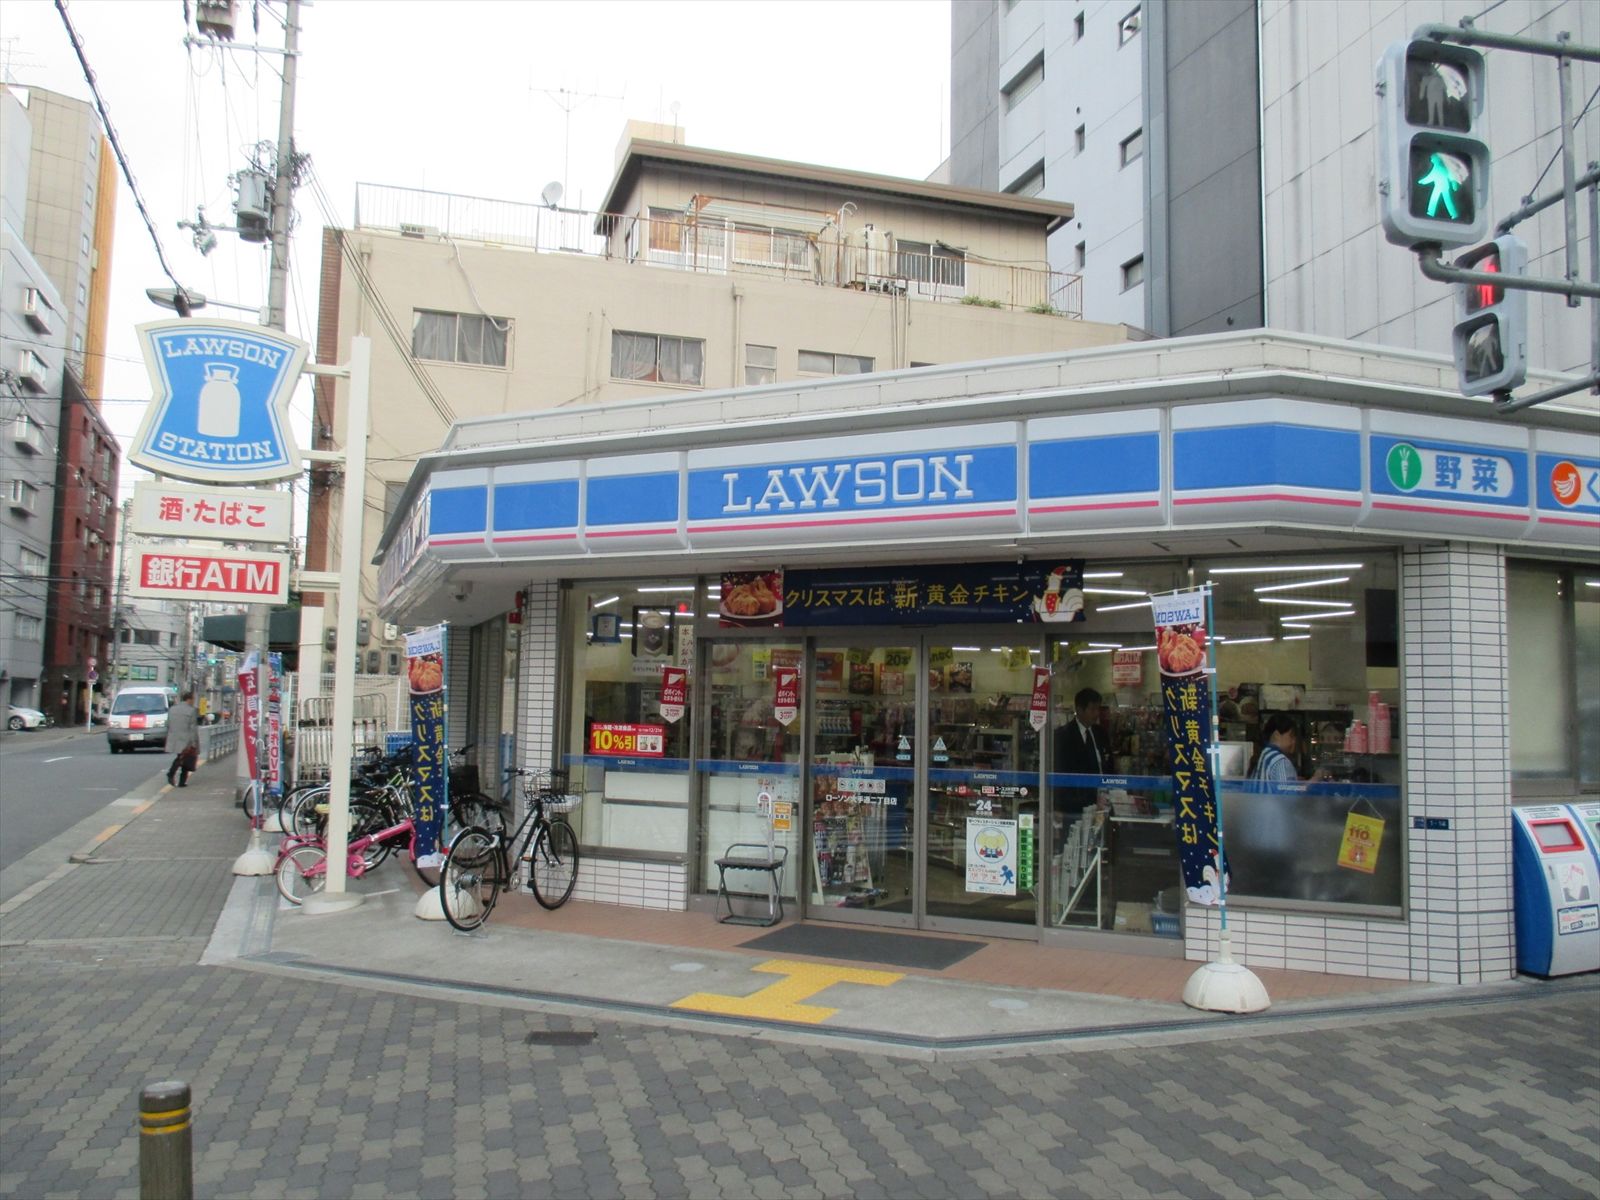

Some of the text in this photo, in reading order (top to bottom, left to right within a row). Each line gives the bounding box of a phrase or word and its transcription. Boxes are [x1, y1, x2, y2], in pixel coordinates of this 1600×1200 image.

[163, 337, 281, 369] LAWSON
[158, 431, 274, 461] STATION
[722, 454, 974, 512] LAWSON
[1434, 454, 1499, 493] 野菜
[159, 496, 266, 527] 酒・たばこ
[147, 557, 274, 592] 銀行ATM
[592, 730, 636, 751] 10%引
[976, 800, 993, 811] 24
